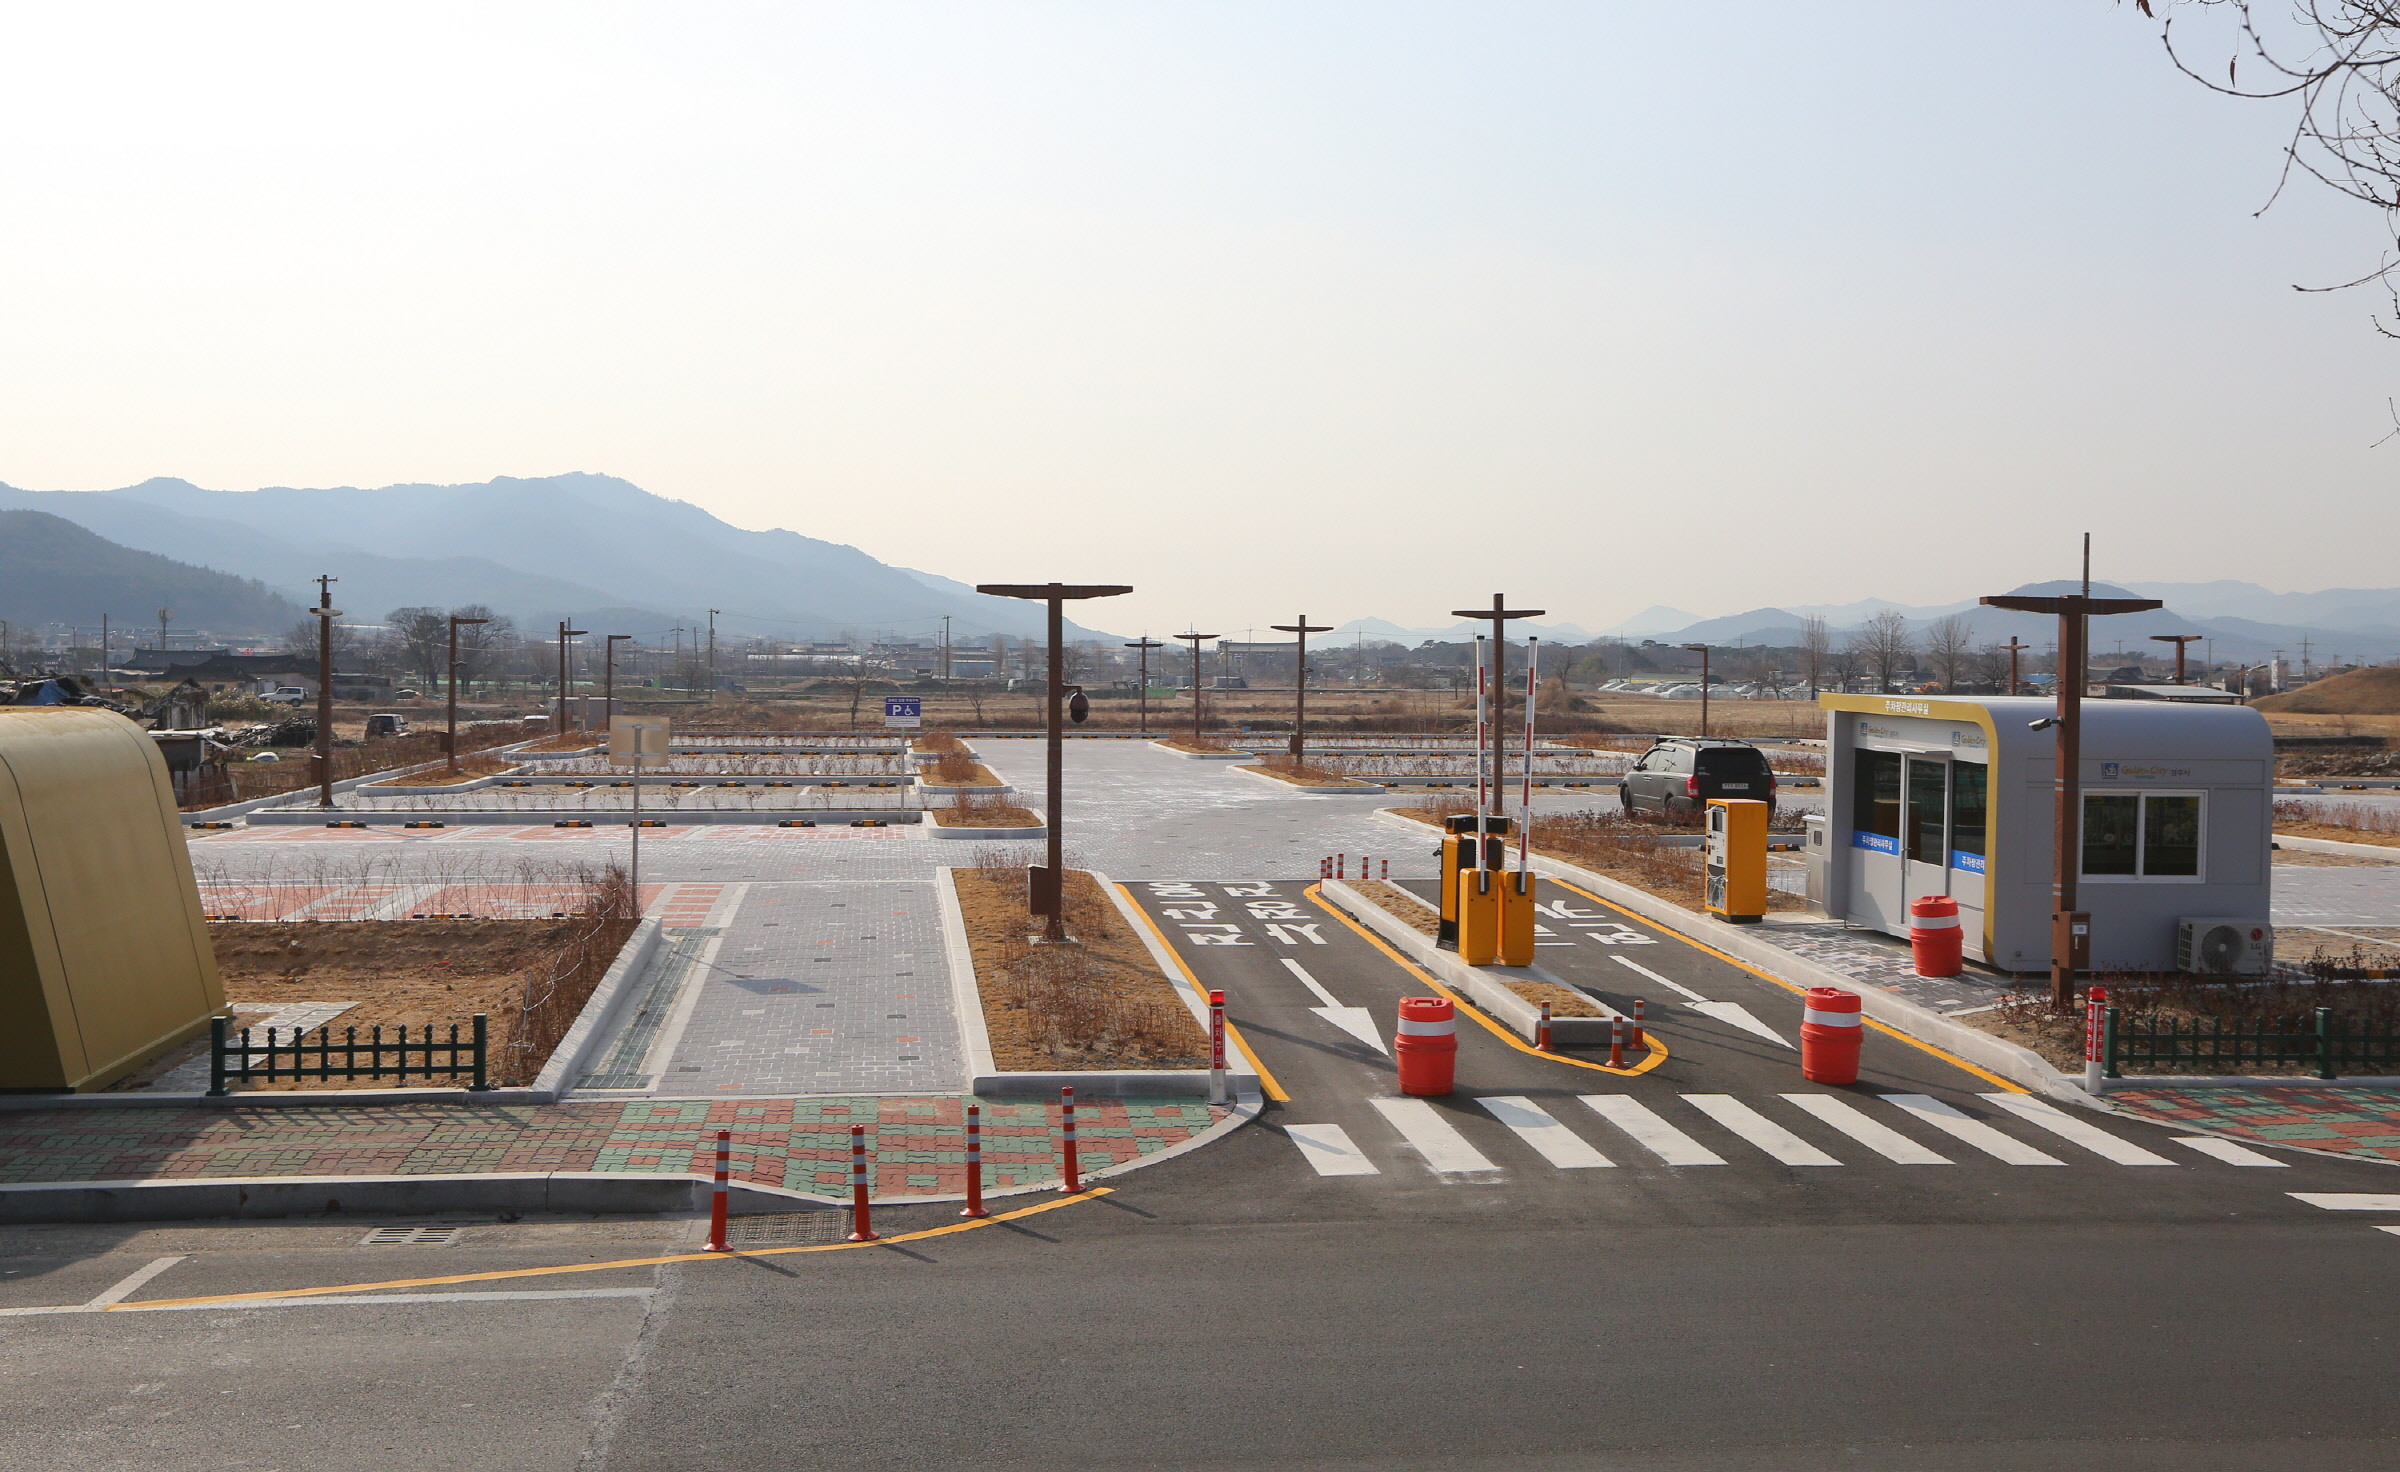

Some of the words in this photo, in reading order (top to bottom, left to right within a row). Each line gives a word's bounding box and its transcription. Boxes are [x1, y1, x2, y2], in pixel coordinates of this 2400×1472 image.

[892, 704, 902, 716] P
[1885, 700, 1929, 715] 주차장관리사무실
[1214, 1014, 1223, 1066] 출차주의
